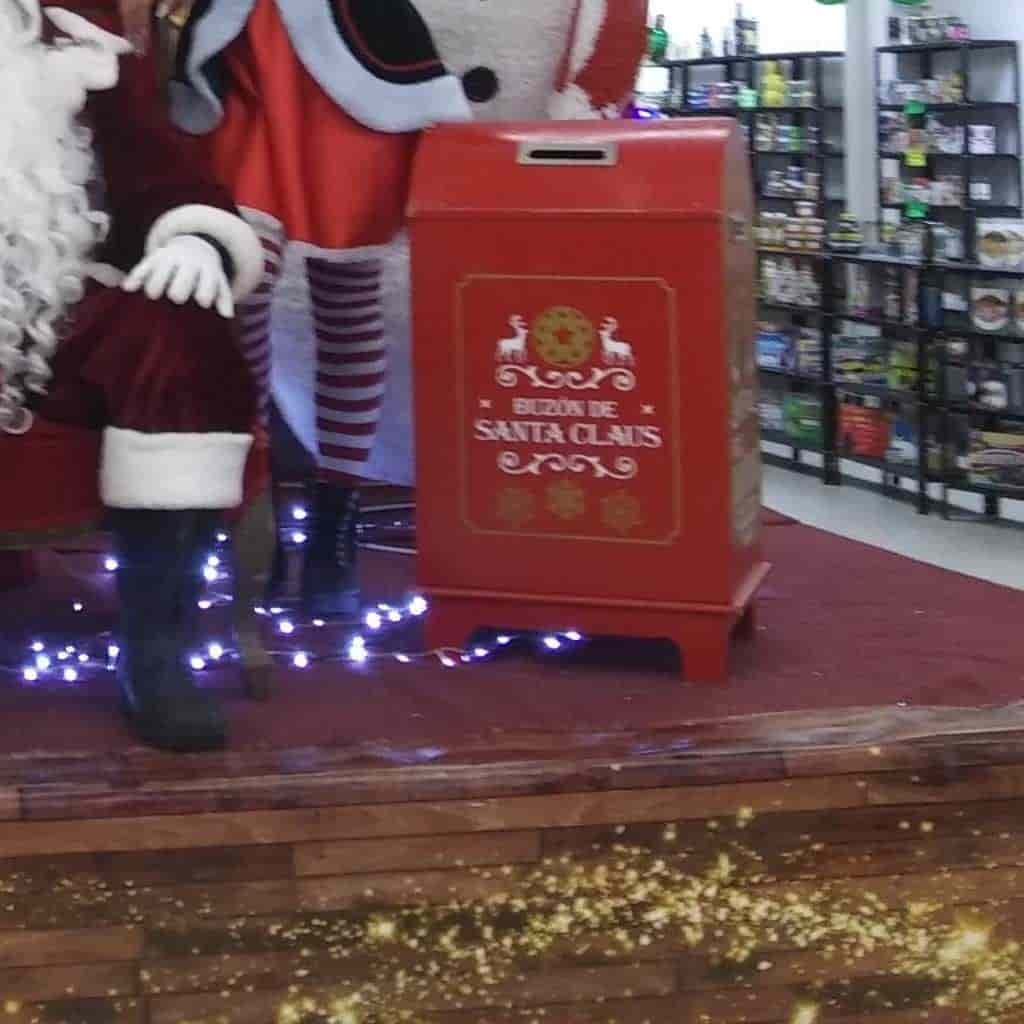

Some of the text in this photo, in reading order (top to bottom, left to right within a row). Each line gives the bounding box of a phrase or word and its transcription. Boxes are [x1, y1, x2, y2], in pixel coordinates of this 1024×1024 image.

[588, 399, 619, 419] DE
[474, 419, 663, 449] SANTA CLAUS
